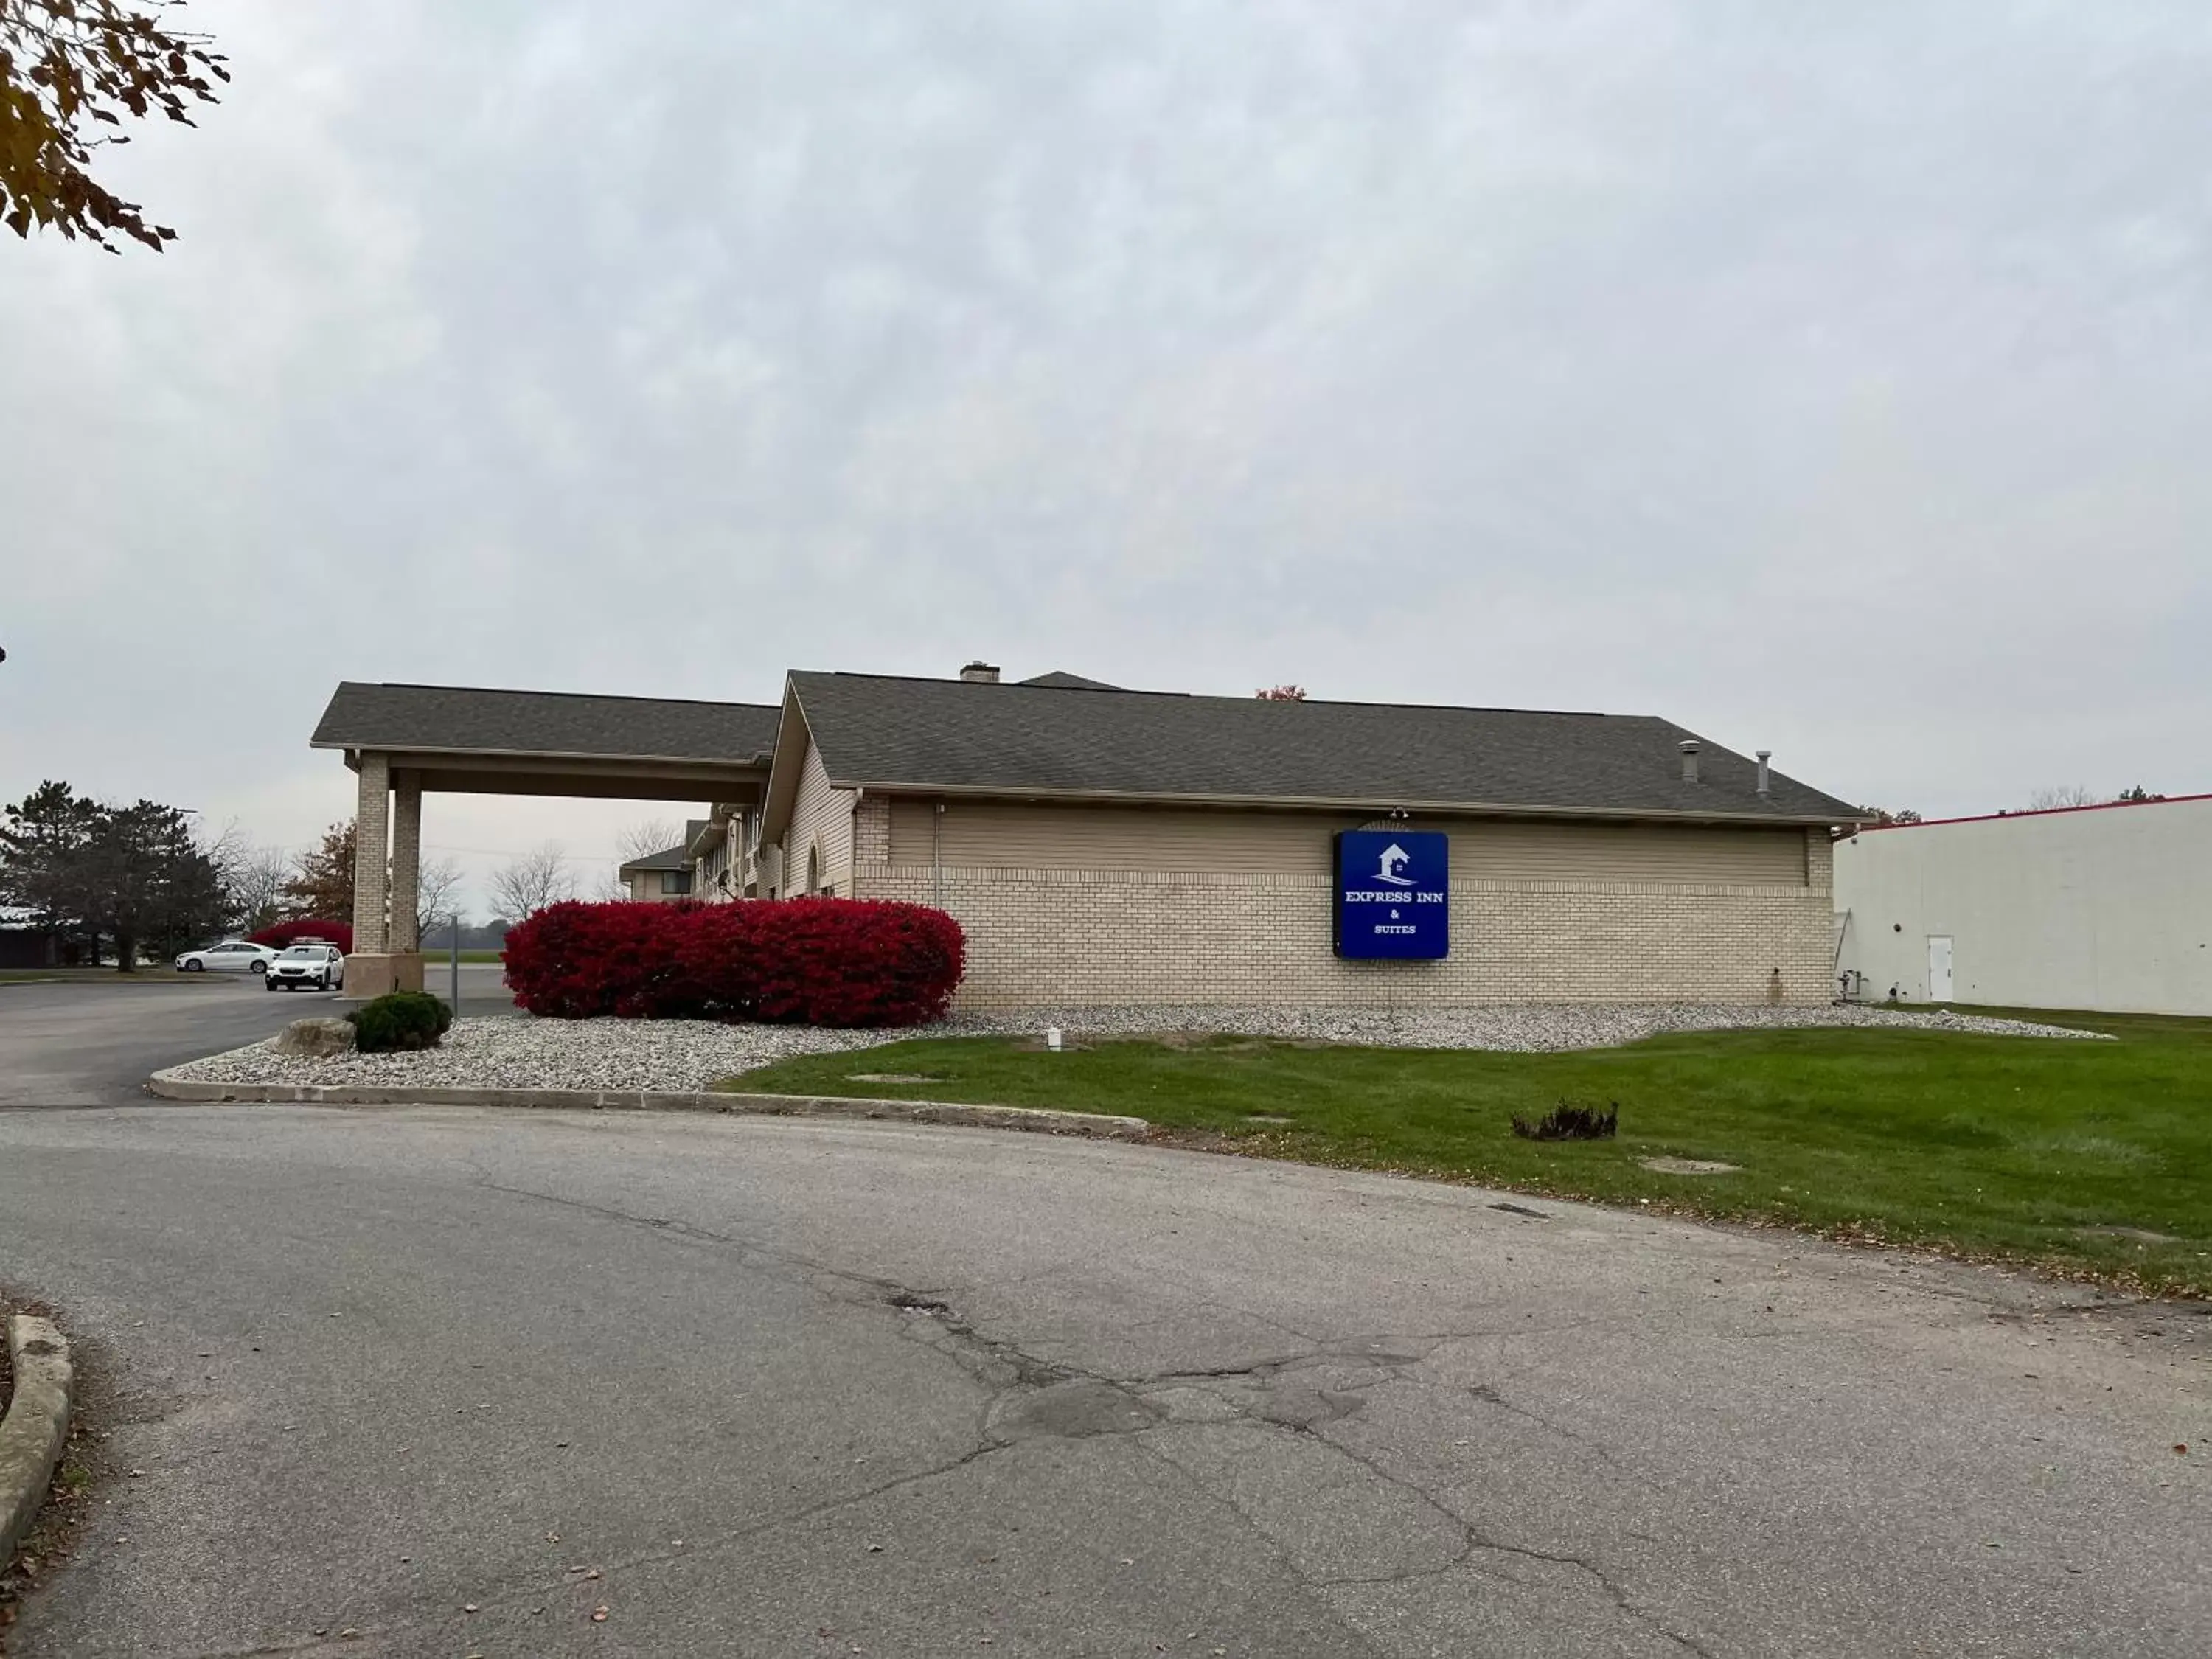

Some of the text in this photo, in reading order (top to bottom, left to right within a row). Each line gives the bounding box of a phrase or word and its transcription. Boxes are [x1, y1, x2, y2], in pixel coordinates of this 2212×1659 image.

[1345, 891, 1444, 903] EXPRESS INN
[1390, 909, 1400, 919] &
[1374, 925, 1416, 934] SUITES
